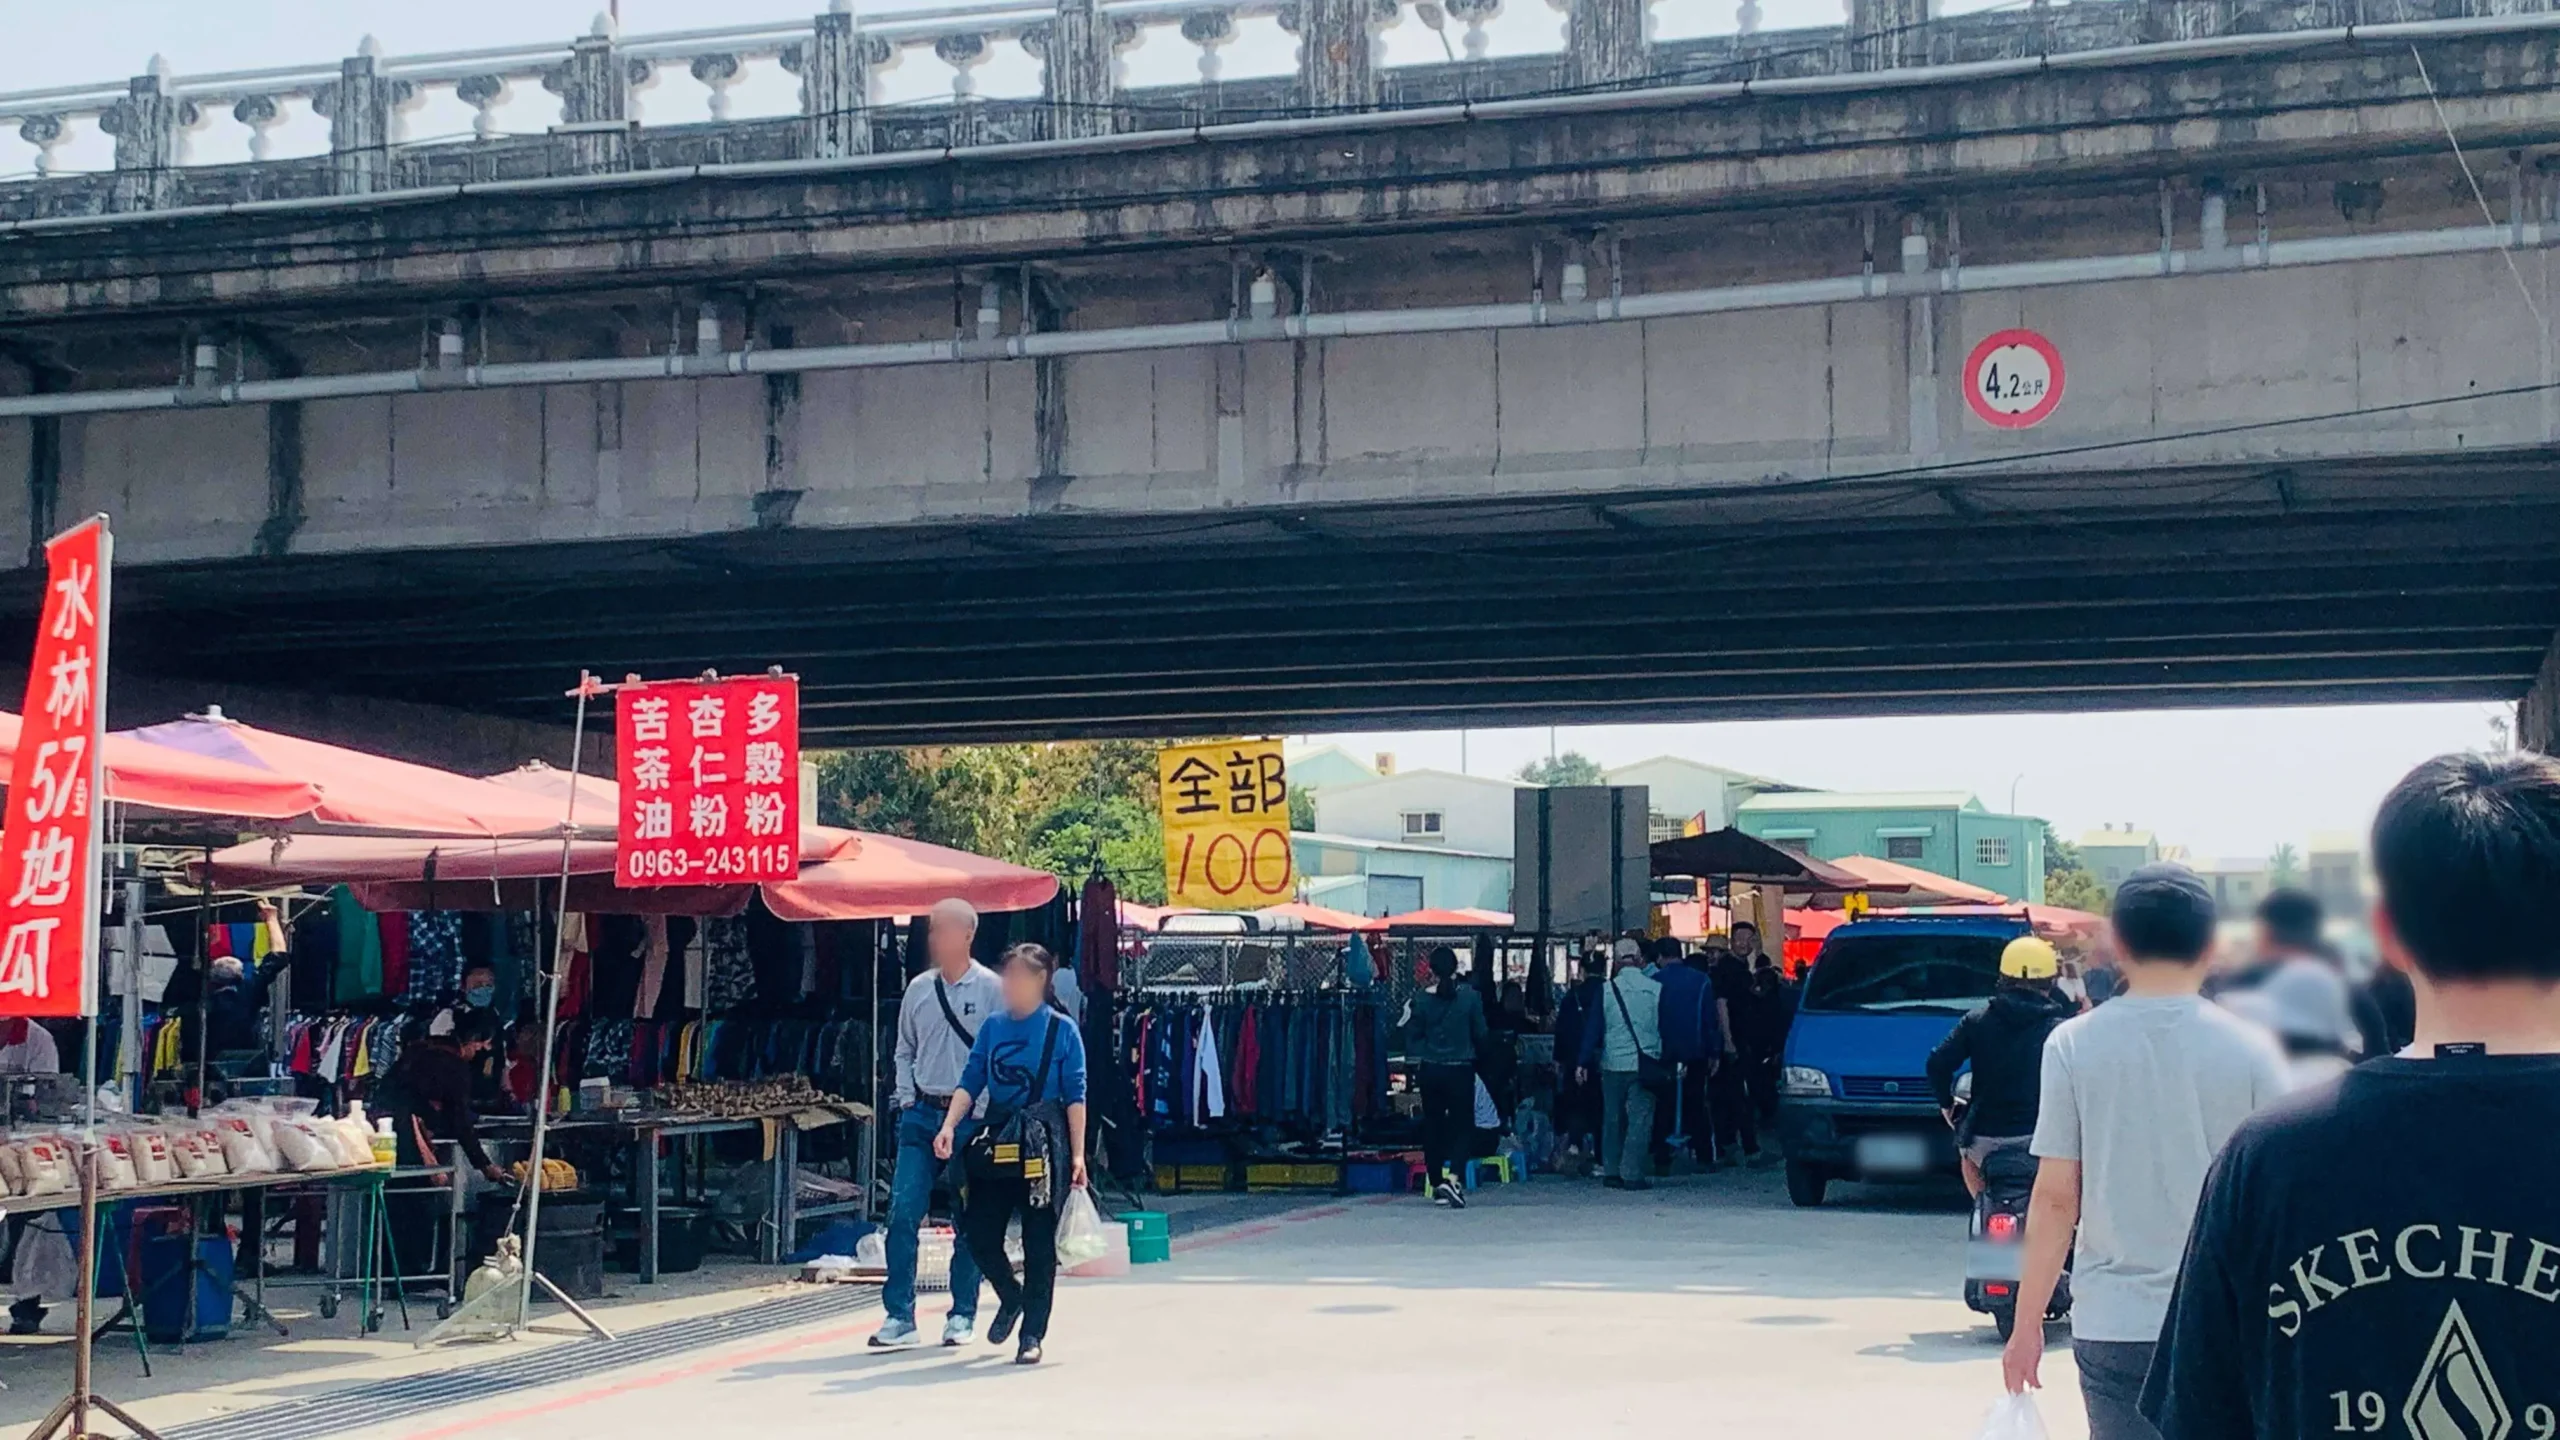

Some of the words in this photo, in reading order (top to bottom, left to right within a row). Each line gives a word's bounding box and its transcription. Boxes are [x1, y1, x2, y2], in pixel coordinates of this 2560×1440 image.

[631, 697, 673, 840] 苦茶油
[688, 695, 729, 838] 杏仁粉
[1168, 750, 1287, 814] 全部
[629, 844, 790, 879] 0963-243115
[1177, 827, 1292, 896] 100
[2330, 1390, 2386, 1432] 19
